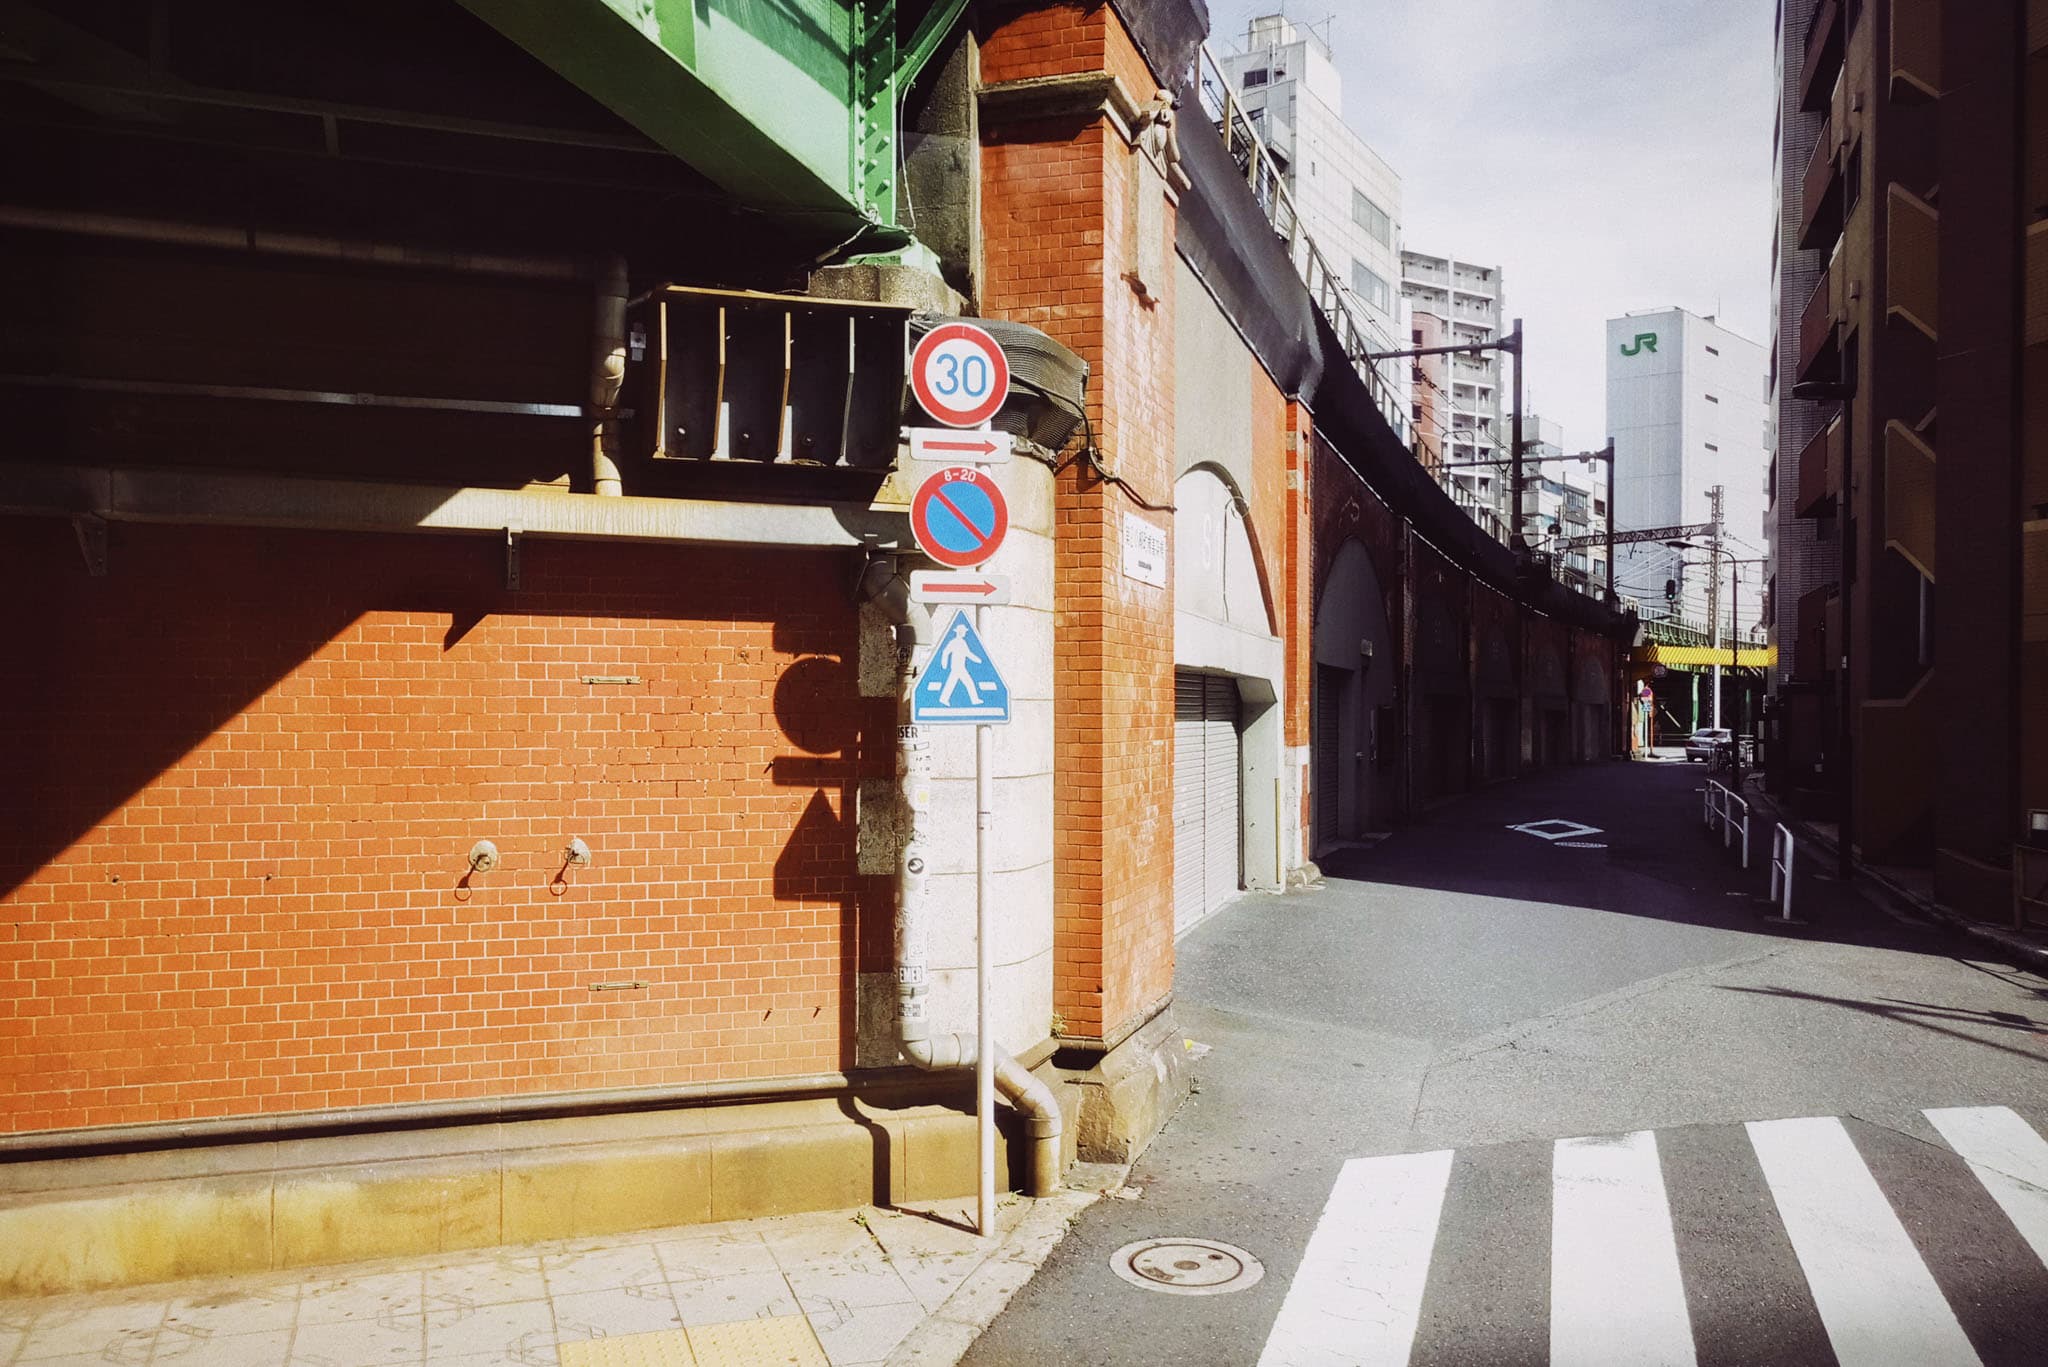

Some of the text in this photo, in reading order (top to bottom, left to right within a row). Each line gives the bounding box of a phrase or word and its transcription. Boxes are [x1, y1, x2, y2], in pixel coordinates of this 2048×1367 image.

[1621, 333, 1657, 356] JR
[936, 353, 987, 397] 30
[944, 469, 977, 482] 8-20
